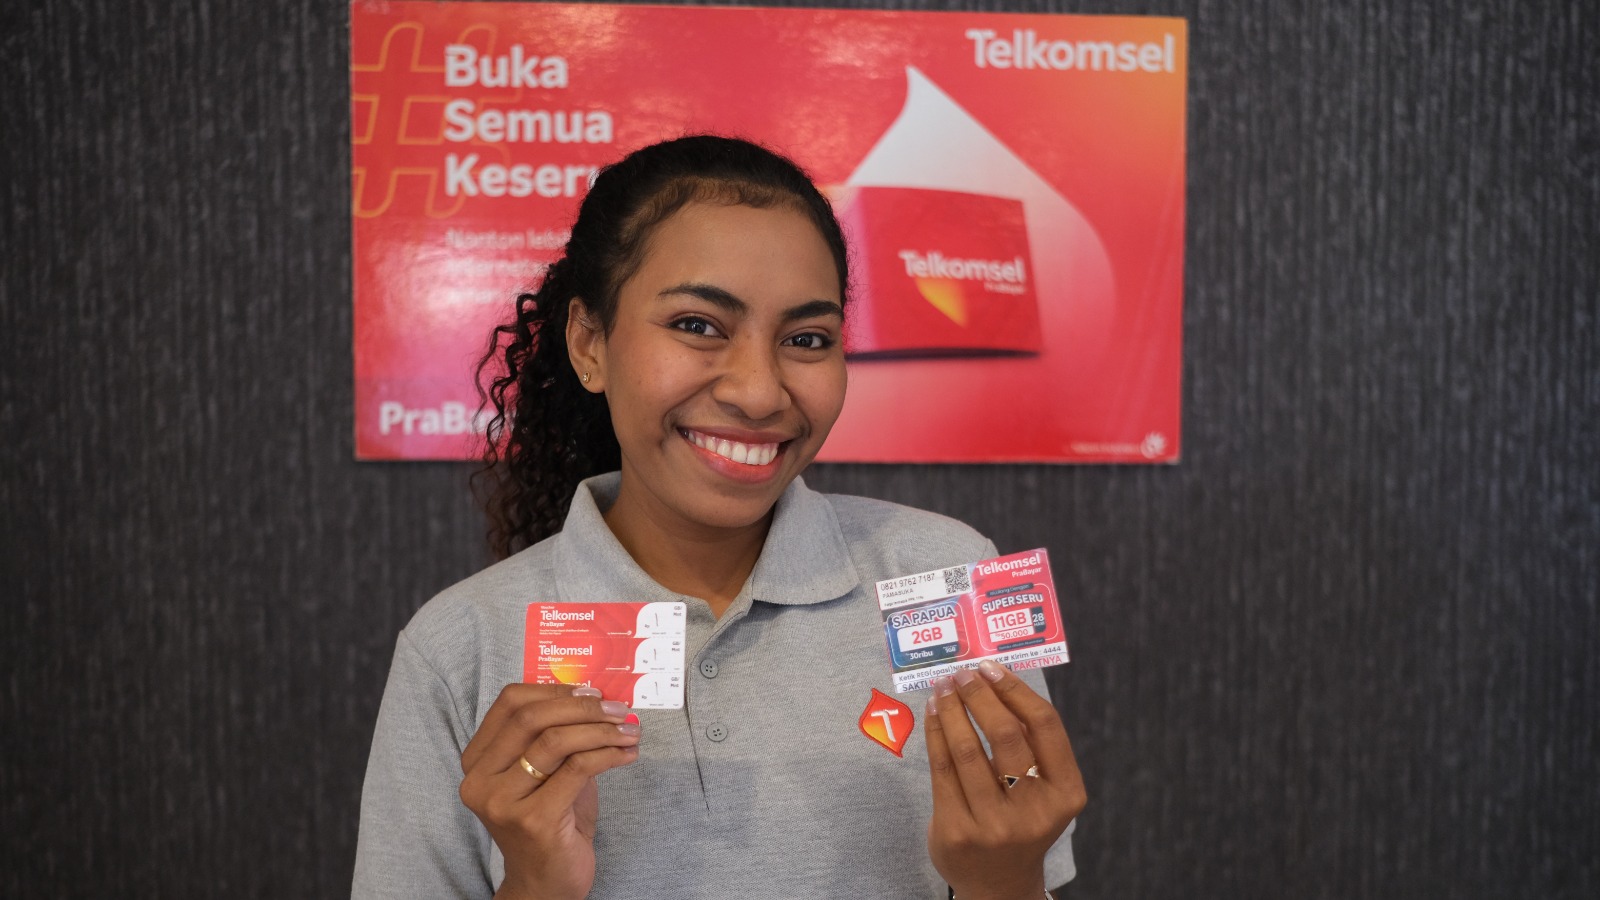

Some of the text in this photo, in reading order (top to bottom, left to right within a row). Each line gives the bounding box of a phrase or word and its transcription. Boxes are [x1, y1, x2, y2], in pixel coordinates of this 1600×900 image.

[965, 29, 1175, 73] Telkomsel
[444, 44, 569, 88] Buka
[443, 98, 613, 143] Semua
[899, 249, 1026, 284] Telkomsel
[976, 553, 1041, 576] Telkomsel
[1012, 567, 1042, 578] PraBayar
[881, 573, 935, 591] 0821 9762 7187
[982, 593, 1044, 614] SUPER SERU
[540, 610, 595, 621] Telkomsel
[893, 605, 956, 628] SA PAPUA
[992, 612, 1027, 629] 11GB
[1032, 612, 1044, 622] 28
[911, 626, 943, 645] 2GB
[538, 644, 593, 656] Telkomsel
[899, 673, 915, 681] Ketik
[1010, 652, 1029, 661] Kirim
[1043, 646, 1062, 654] 4444
[1013, 655, 1063, 671] PAKETNYA
[902, 680, 928, 692] SAKTI
